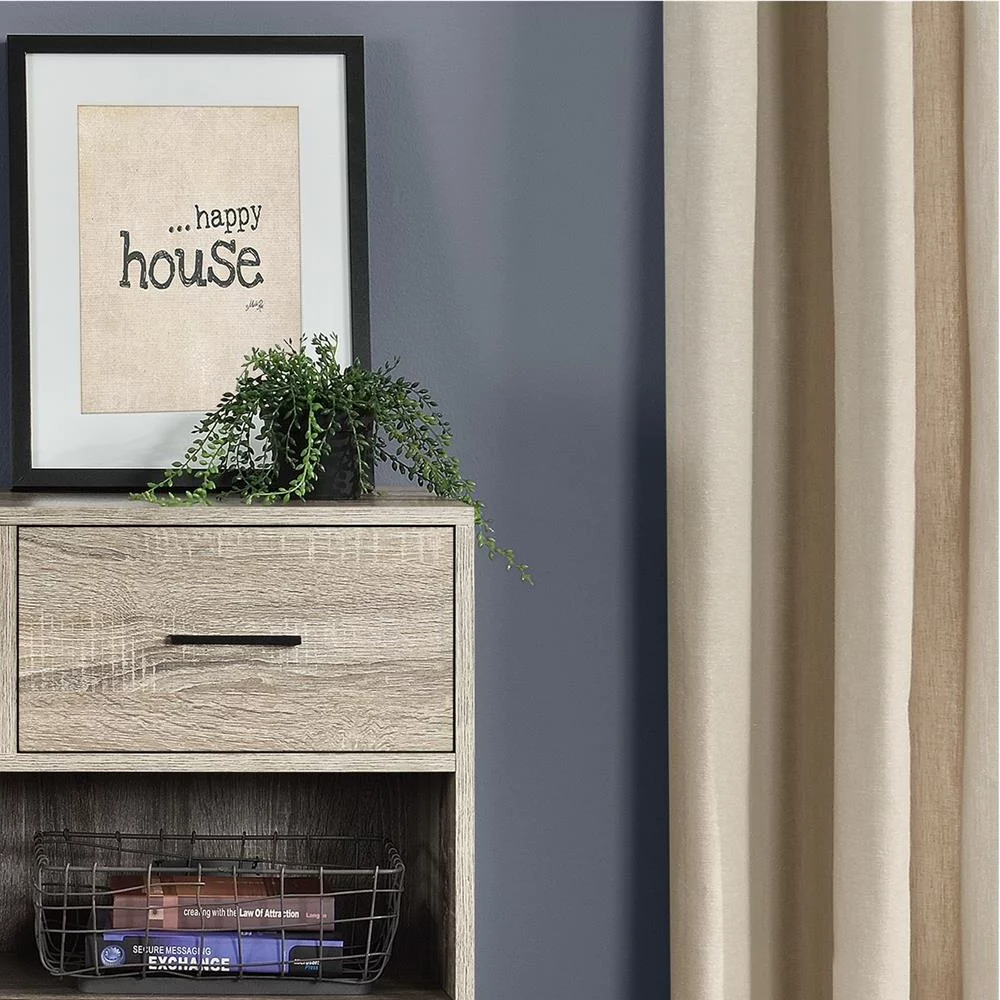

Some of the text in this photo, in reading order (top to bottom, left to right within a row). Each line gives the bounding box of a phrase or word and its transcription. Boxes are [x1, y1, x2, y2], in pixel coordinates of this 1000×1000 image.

[119, 230, 265, 290] house
[183, 907, 211, 919] creang
[212, 907, 226, 917] with
[226, 908, 237, 917] the
[239, 908, 253, 918] Law
[255, 908, 263, 918] Of
[132, 945, 165, 954] SECURE
[148, 955, 231, 972] EXCHANGE
